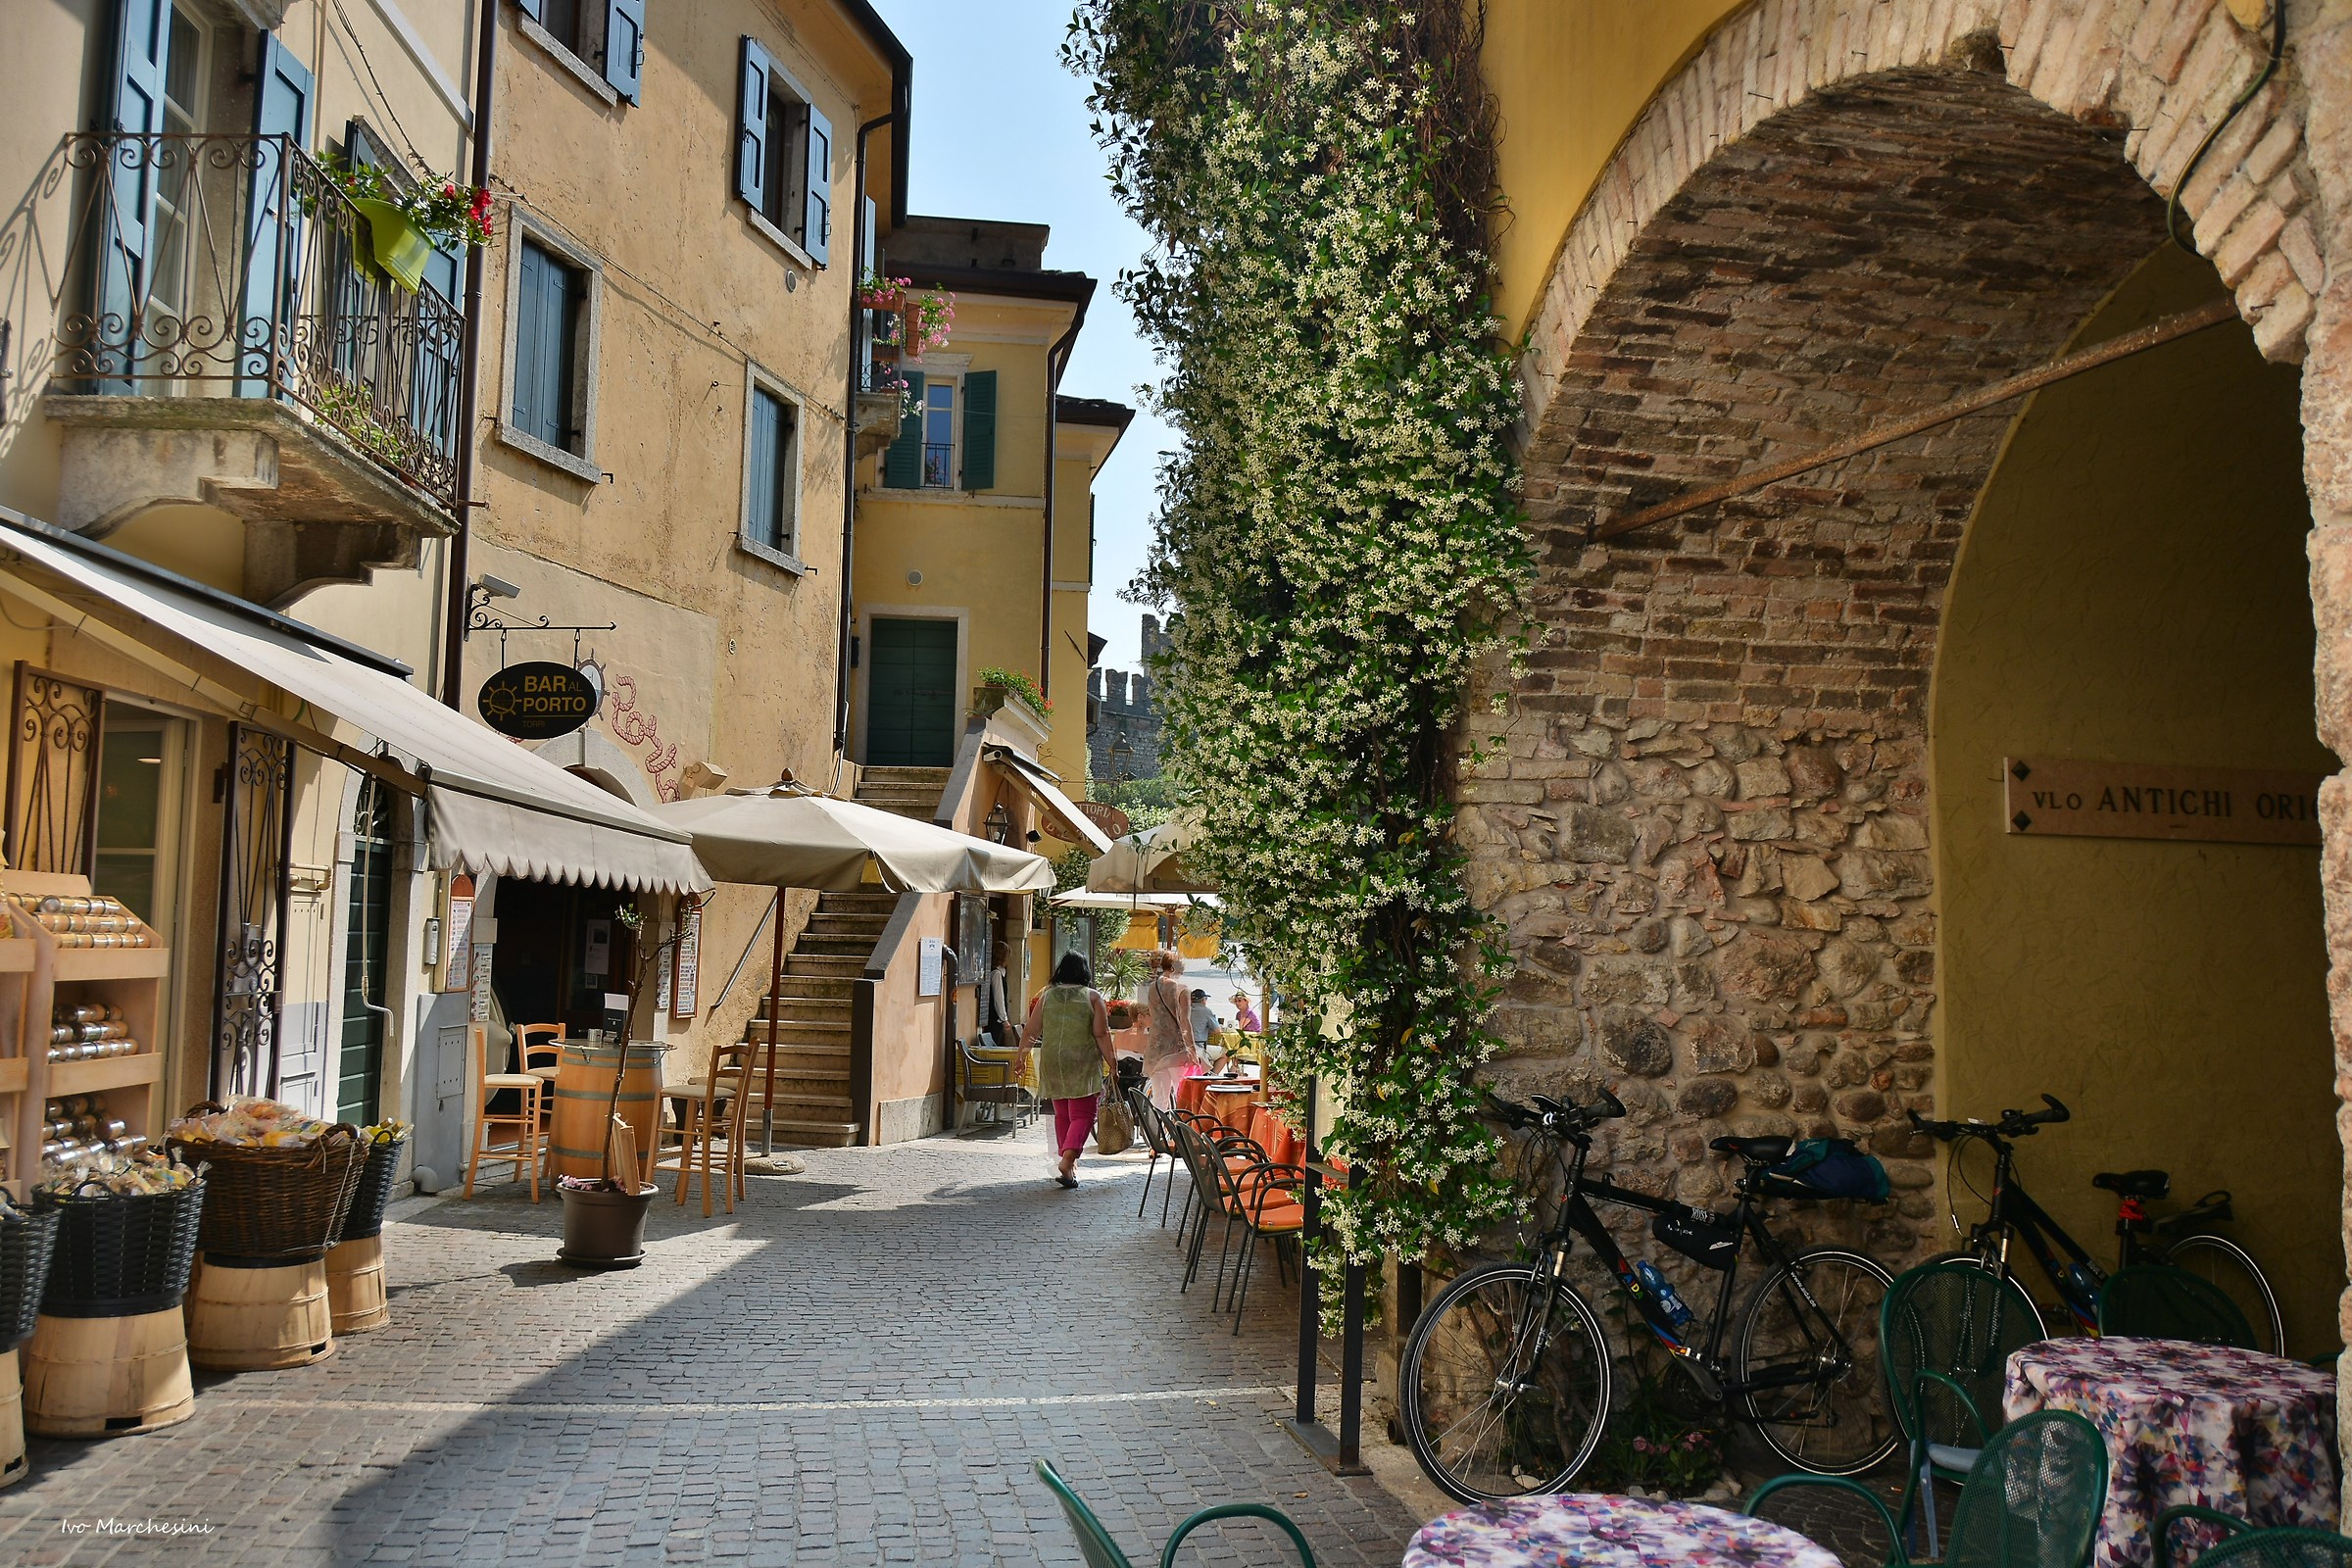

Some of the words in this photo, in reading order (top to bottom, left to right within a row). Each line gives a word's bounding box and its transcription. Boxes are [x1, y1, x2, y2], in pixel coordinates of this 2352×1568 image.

[523, 674, 567, 693] BAR
[567, 681, 583, 692] AL
[522, 696, 587, 712] PORTO
[2032, 791, 2082, 810] VLO
[2097, 787, 2232, 817] ANTICHI
[1077, 804, 1115, 819] TTORIA
